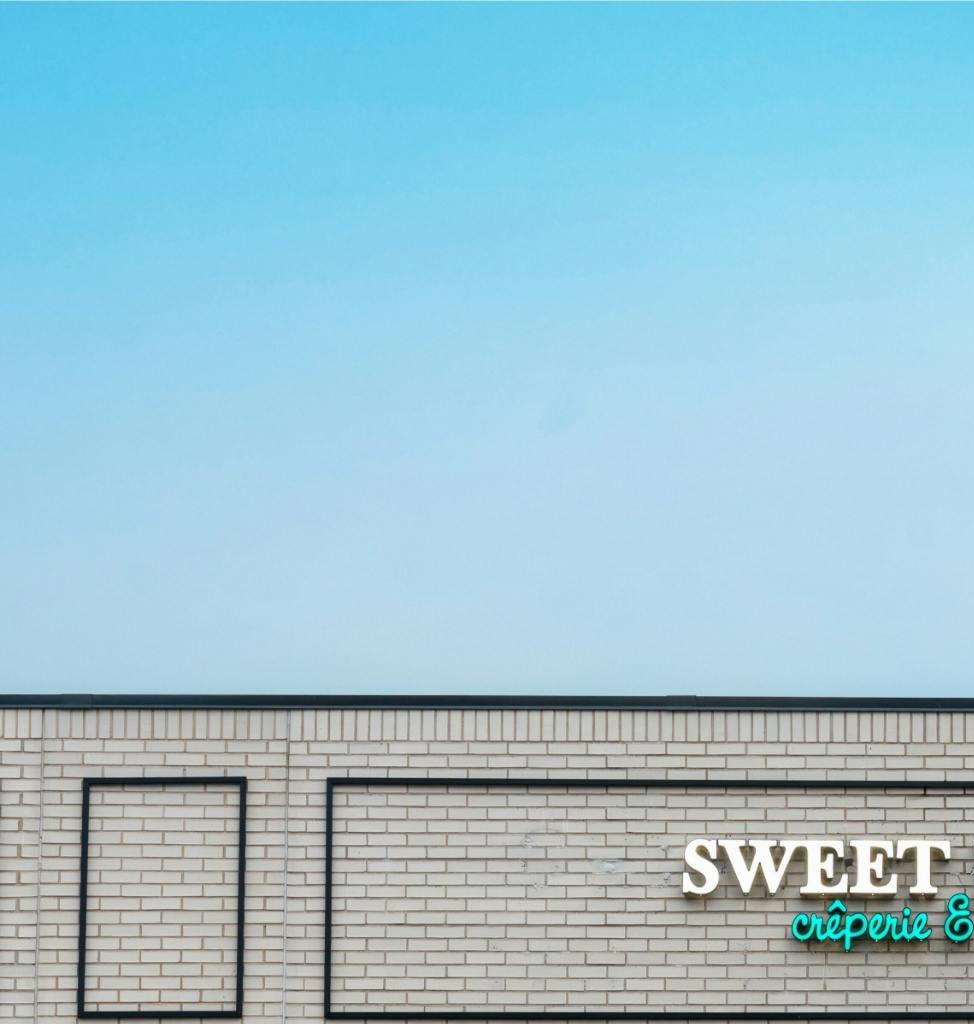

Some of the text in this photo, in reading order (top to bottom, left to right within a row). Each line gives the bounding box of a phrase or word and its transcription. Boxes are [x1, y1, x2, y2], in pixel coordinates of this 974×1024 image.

[682, 838, 951, 895] SWEET
[791, 901, 931, 952] crêperie
[944, 893, 974, 942] &
